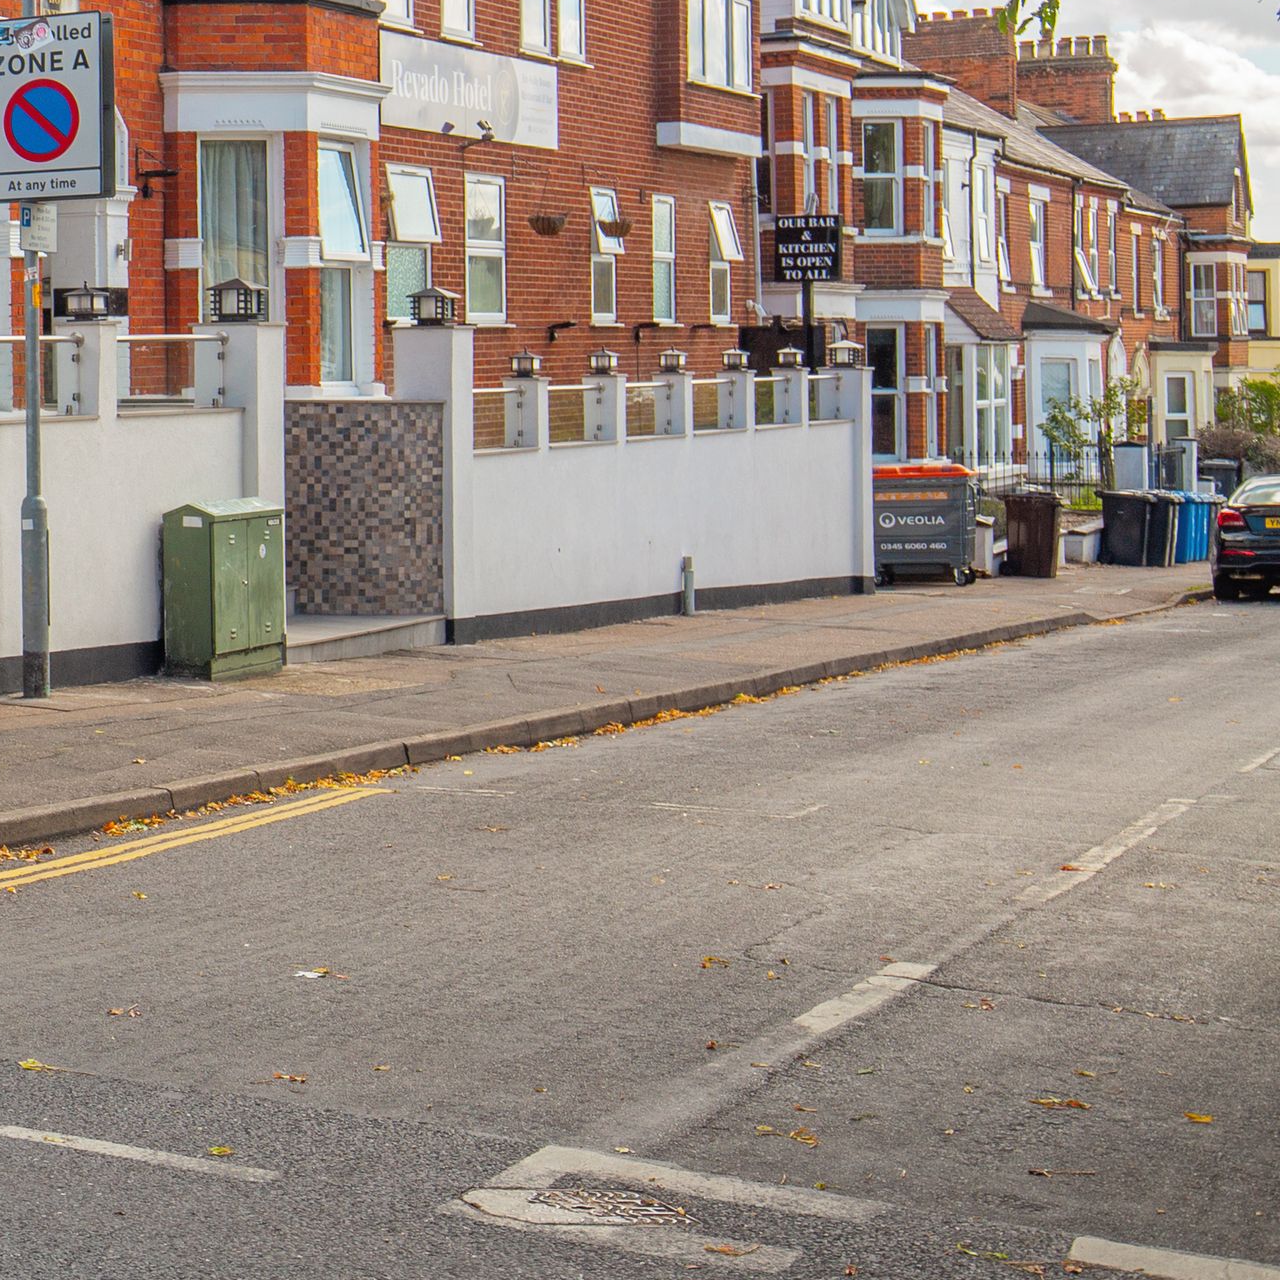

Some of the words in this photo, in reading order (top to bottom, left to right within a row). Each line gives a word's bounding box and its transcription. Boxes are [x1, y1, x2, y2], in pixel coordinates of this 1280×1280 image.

[72, 49, 90, 70] A
[391, 59, 449, 104] Revado
[452, 71, 493, 112] Hotel
[8, 180, 22, 191] At
[25, 181, 47, 192] any
[51, 178, 76, 189] time
[23, 209, 30, 225] P
[778, 218, 806, 228] OUR
[809, 217, 835, 227] BAR
[801, 230, 812, 240] &
[778, 243, 836, 254] KITCHEN
[781, 256, 794, 267] IS
[796, 256, 832, 266] OPEN
[784, 269, 802, 280] TO
[805, 269, 830, 279] ALL
[897, 515, 945, 525] VEOLIA
[905, 542, 927, 550] 6060
